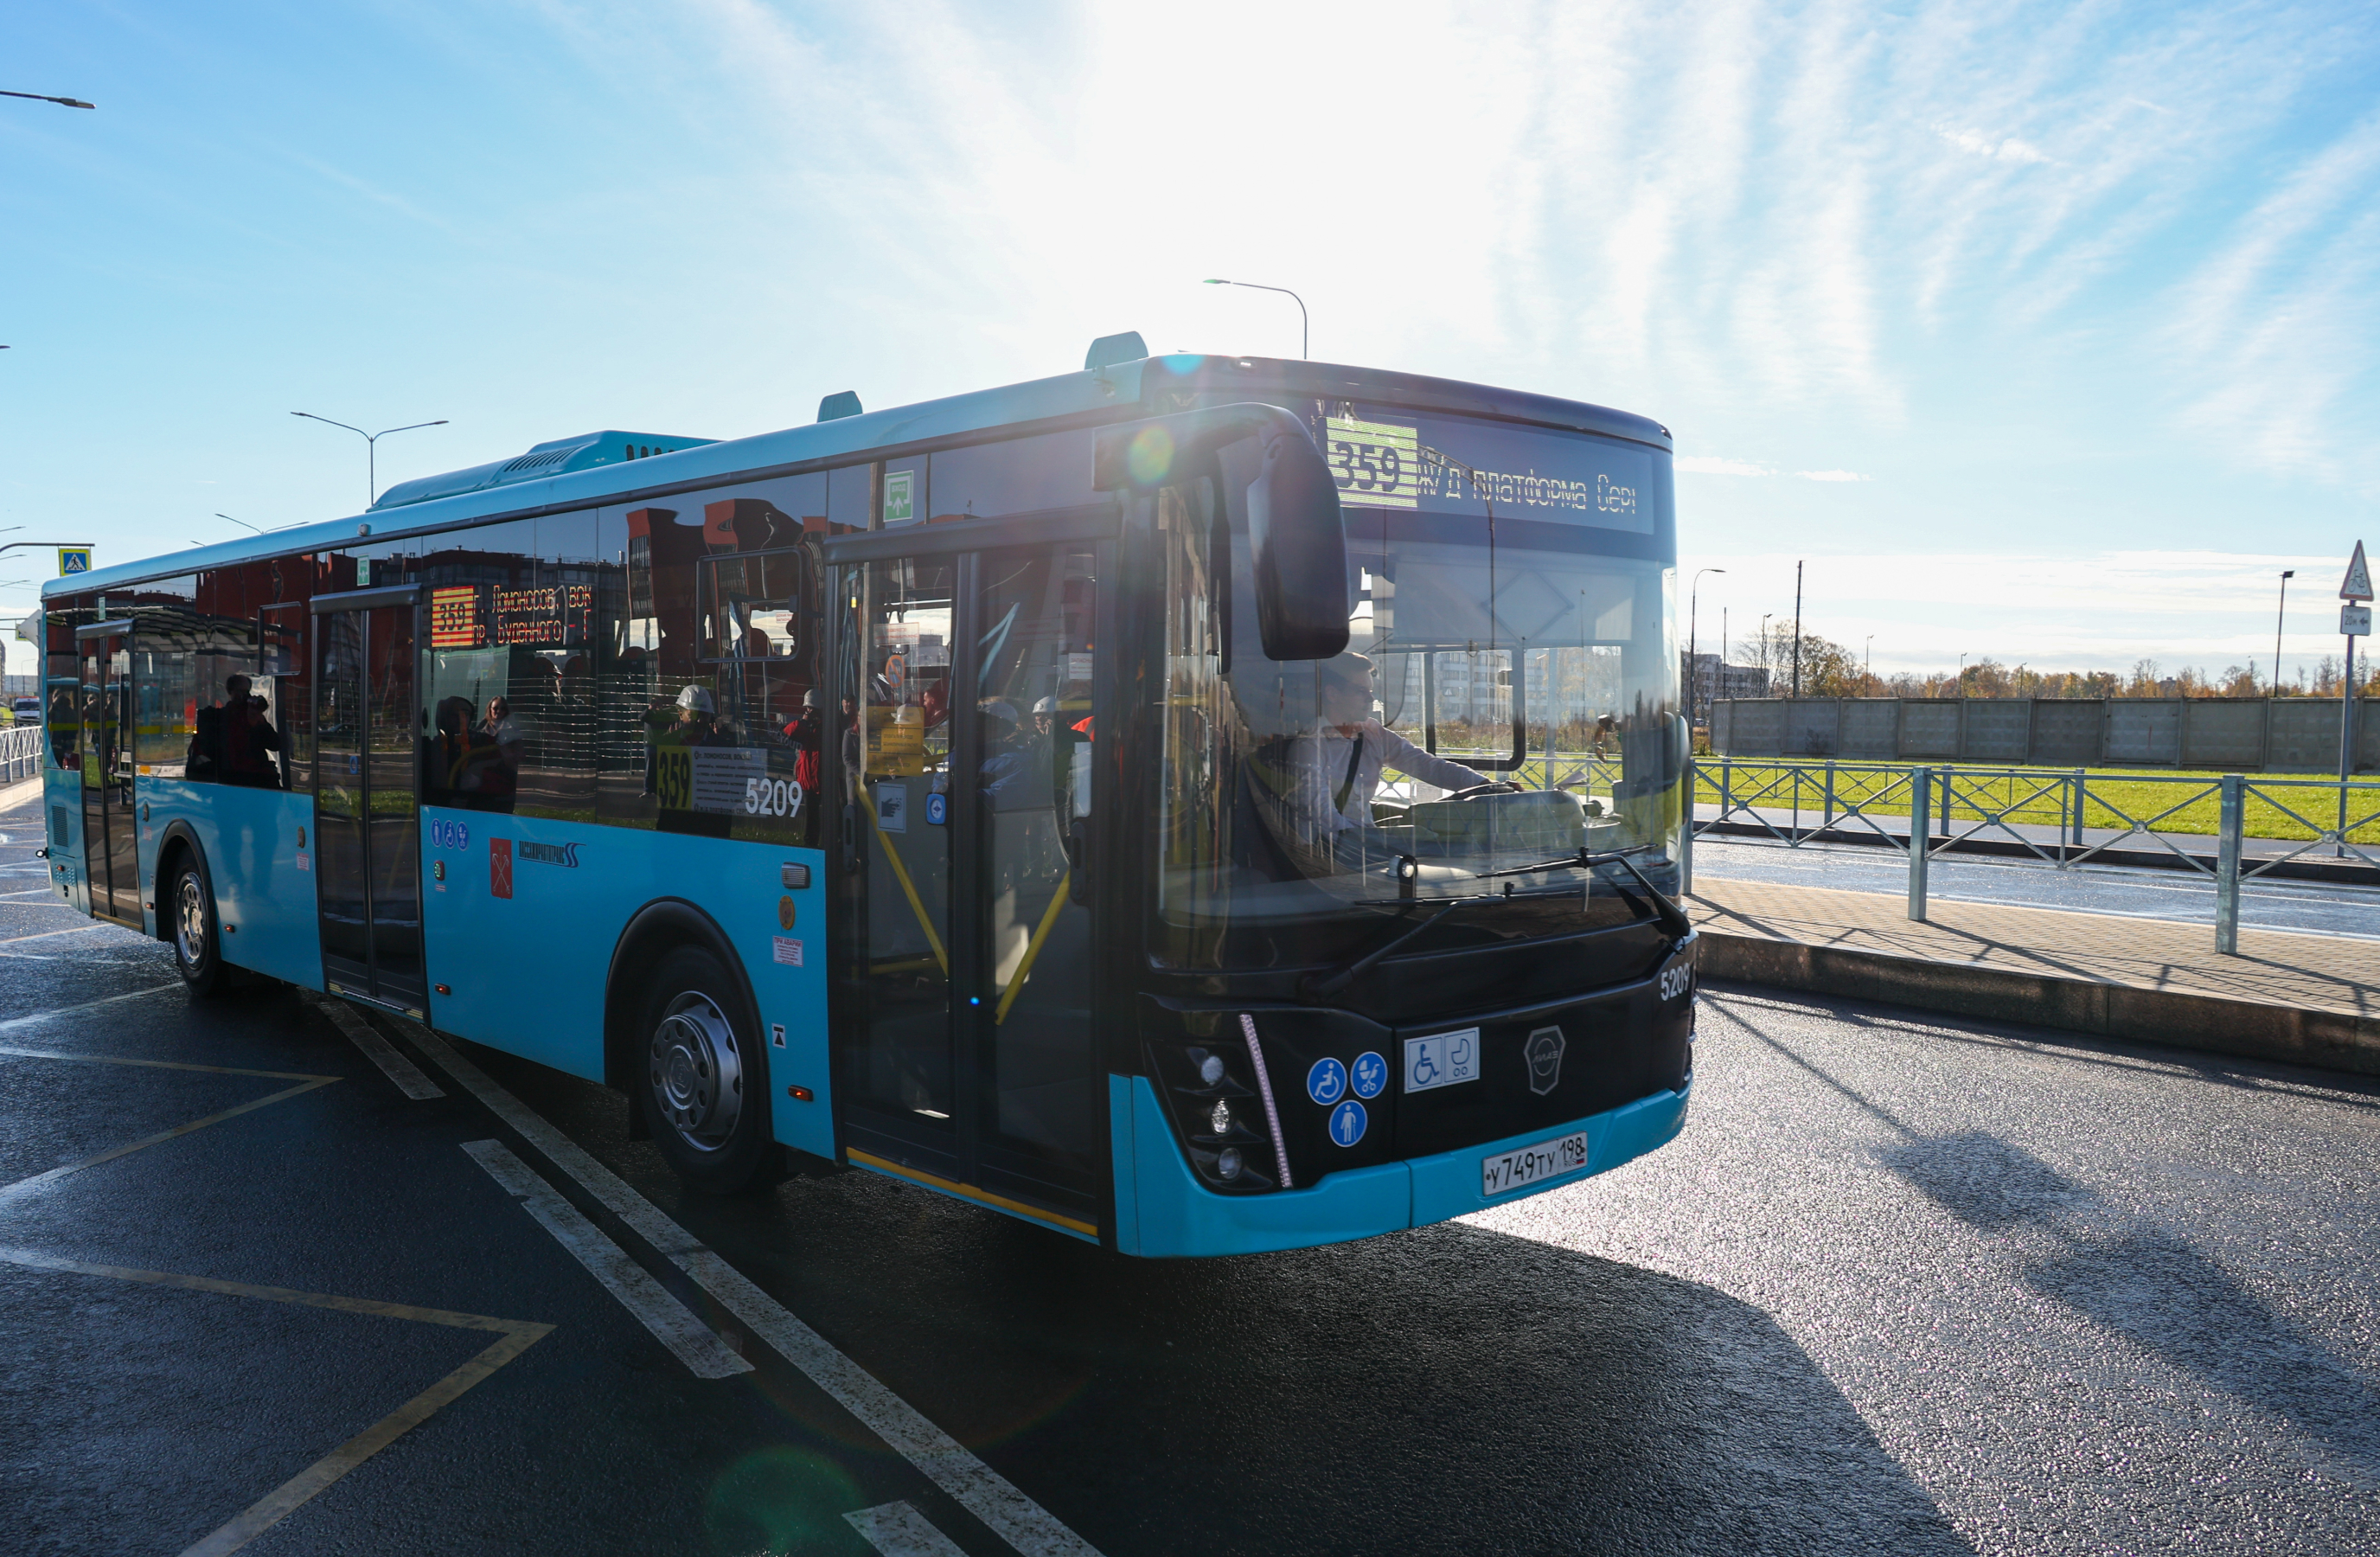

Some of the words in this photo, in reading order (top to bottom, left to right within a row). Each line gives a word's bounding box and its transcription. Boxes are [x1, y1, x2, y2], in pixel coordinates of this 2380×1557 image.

[1334, 441, 1400, 493] 359
[438, 602, 466, 631] 359
[658, 750, 690, 809] 359
[745, 778, 803, 817] 5209
[1660, 962, 1691, 1002] 5209
[1559, 1137, 1583, 1161] 198
[1564, 1158, 1577, 1168] RUS
